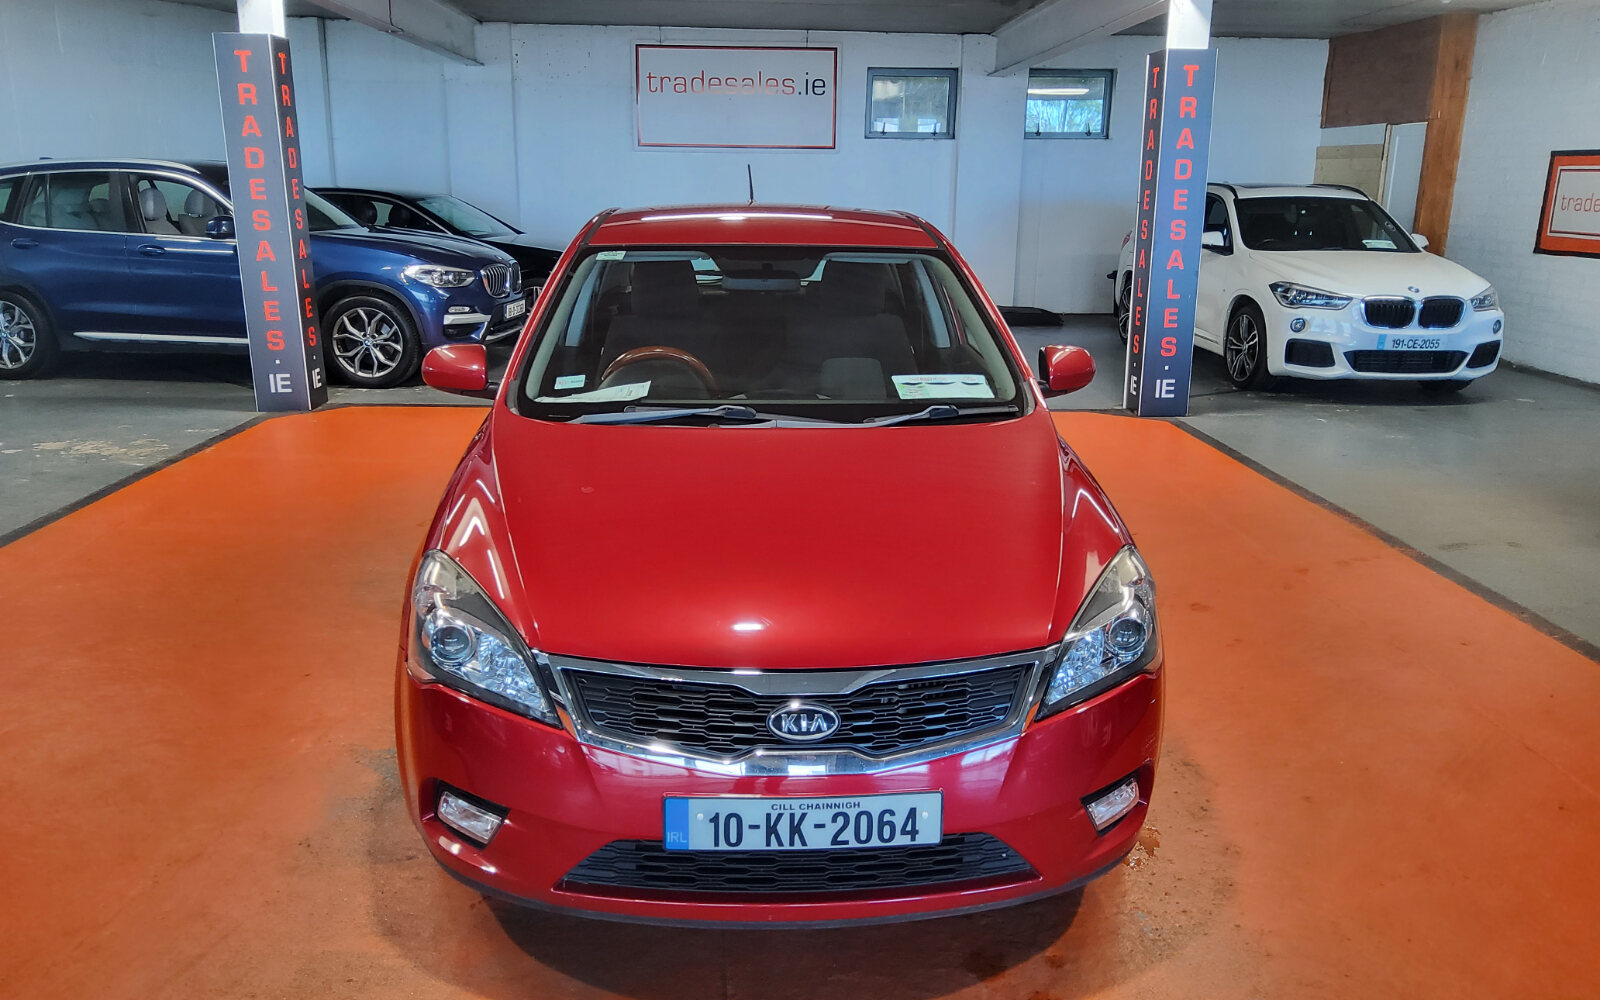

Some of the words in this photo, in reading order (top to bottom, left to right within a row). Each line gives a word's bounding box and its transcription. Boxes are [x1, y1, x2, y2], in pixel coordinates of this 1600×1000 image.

[646, 70, 826, 96] tradesales.ie
[1392, 338, 1440, 349] 191-CE-2055
[781, 714, 828, 733] KIA
[771, 803, 796, 811] CILL
[798, 801, 861, 811] CHAINNIGH
[708, 807, 919, 848] 10-KK-2064
[667, 832, 688, 844] IRL
